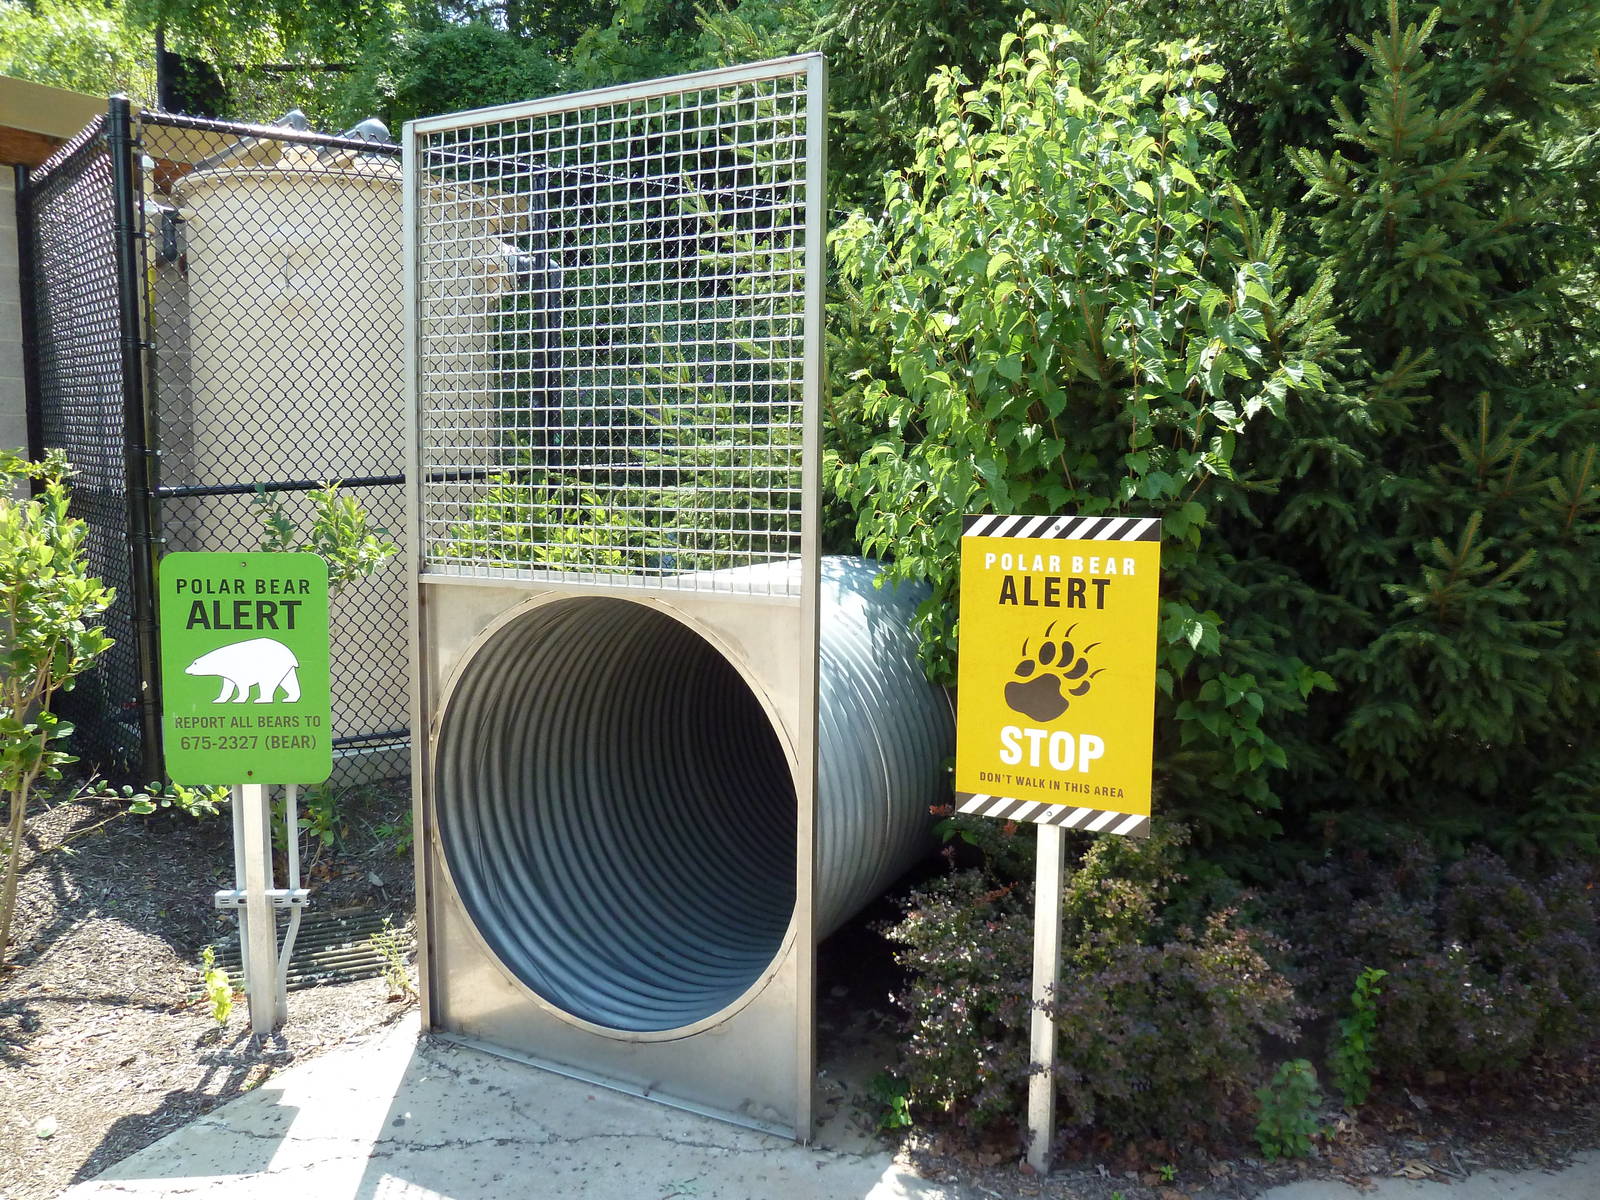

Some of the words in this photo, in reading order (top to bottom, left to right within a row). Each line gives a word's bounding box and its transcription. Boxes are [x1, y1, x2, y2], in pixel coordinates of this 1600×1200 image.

[985, 552, 1061, 573] POLAR
[1072, 555, 1136, 576] BEAR
[176, 578, 246, 595] POLAR
[255, 578, 311, 595] BEAR
[998, 575, 1111, 610] ALERT
[185, 600, 302, 630] ALERT
[175, 716, 226, 729] REPORT
[230, 716, 253, 728] ALL
[257, 715, 300, 728] BEARS
[304, 715, 321, 728] TO
[180, 735, 258, 750] 675-2327
[264, 734, 317, 750] (BEAR)
[999, 725, 1105, 773] STOP
[979, 771, 1012, 785] DON'T
[1015, 775, 1046, 789] WALK
[1049, 779, 1061, 791] IN
[1064, 781, 1091, 795] THIS
[1094, 785, 1125, 799] AREA
